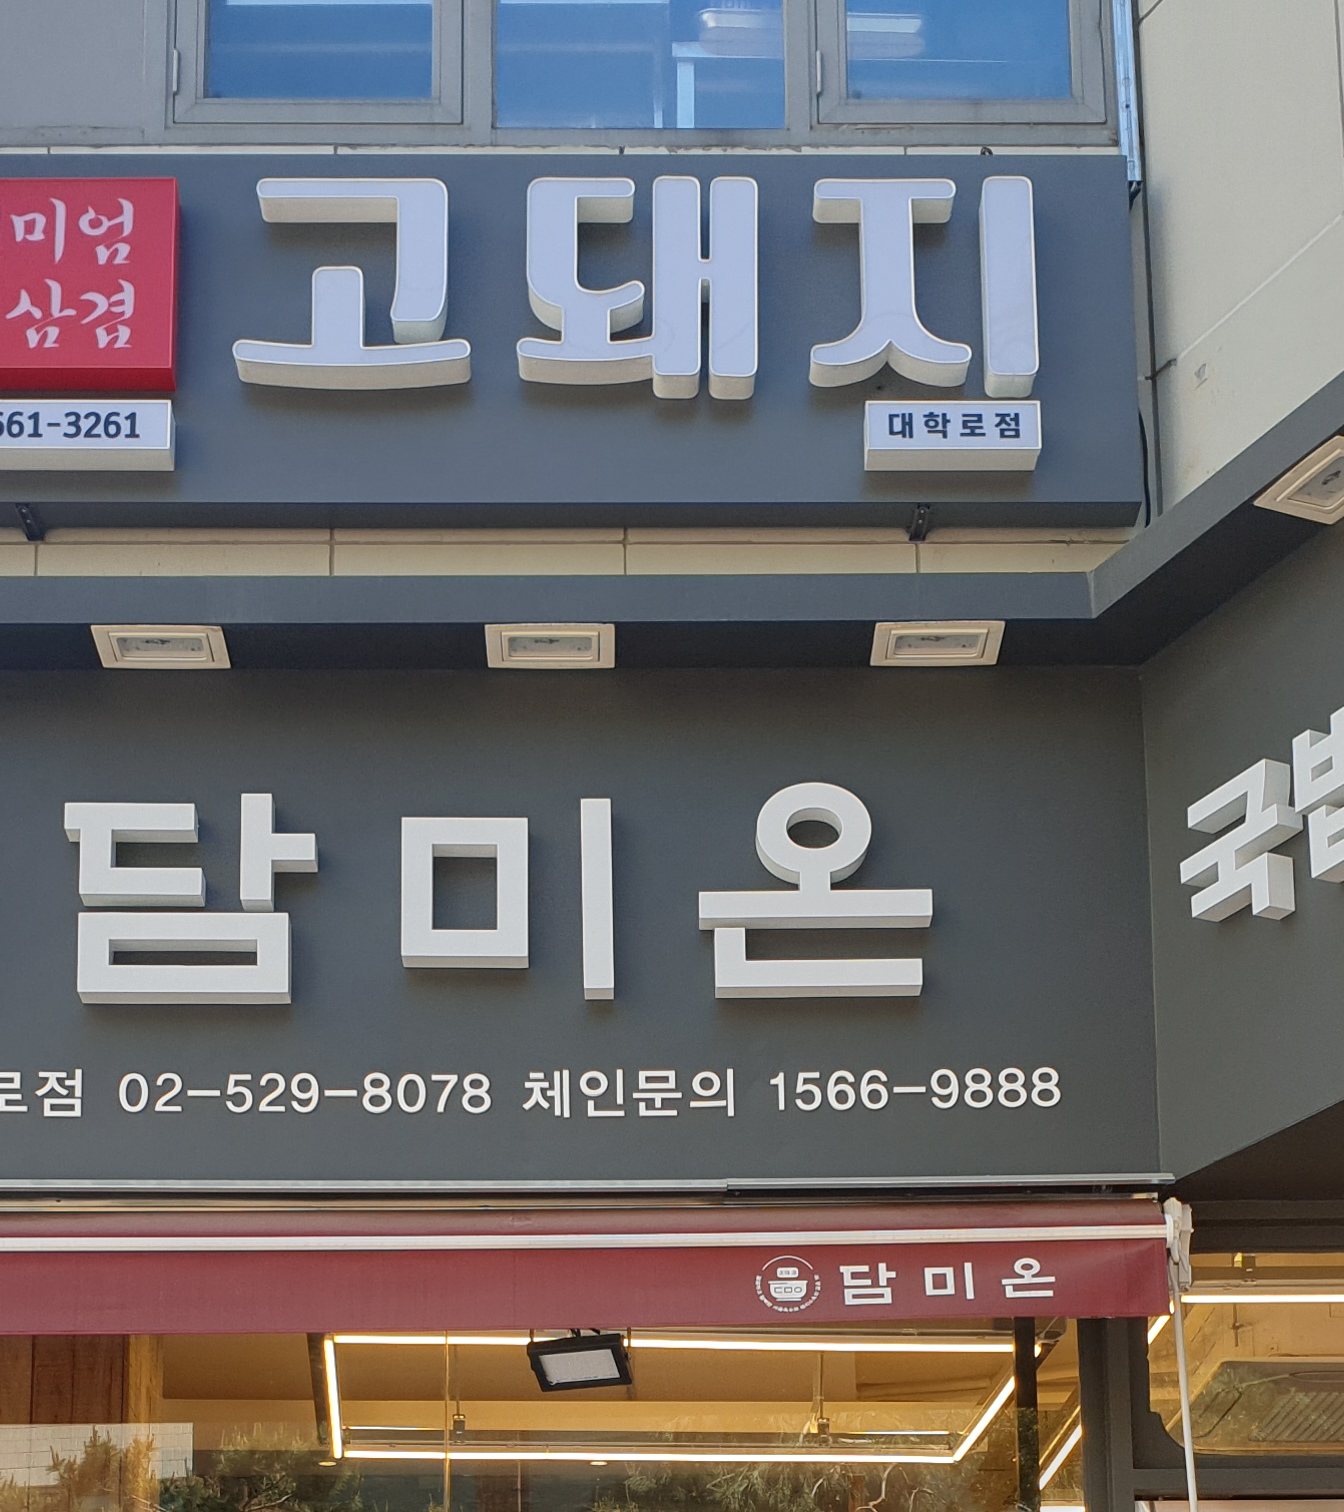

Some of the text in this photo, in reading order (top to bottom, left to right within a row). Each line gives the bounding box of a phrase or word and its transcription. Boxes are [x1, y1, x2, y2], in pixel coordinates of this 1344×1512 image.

[233, 176, 1040, 398] 고돼지
[886, 411, 1023, 440] 대학로점
[64, 782, 933, 1005] 담미온
[117, 1072, 493, 1116] 02-529-8078
[522, 1068, 737, 1120] 체인문의
[768, 1066, 1062, 1113] 1566-9888
[839, 1258, 1056, 1306] 담미온
